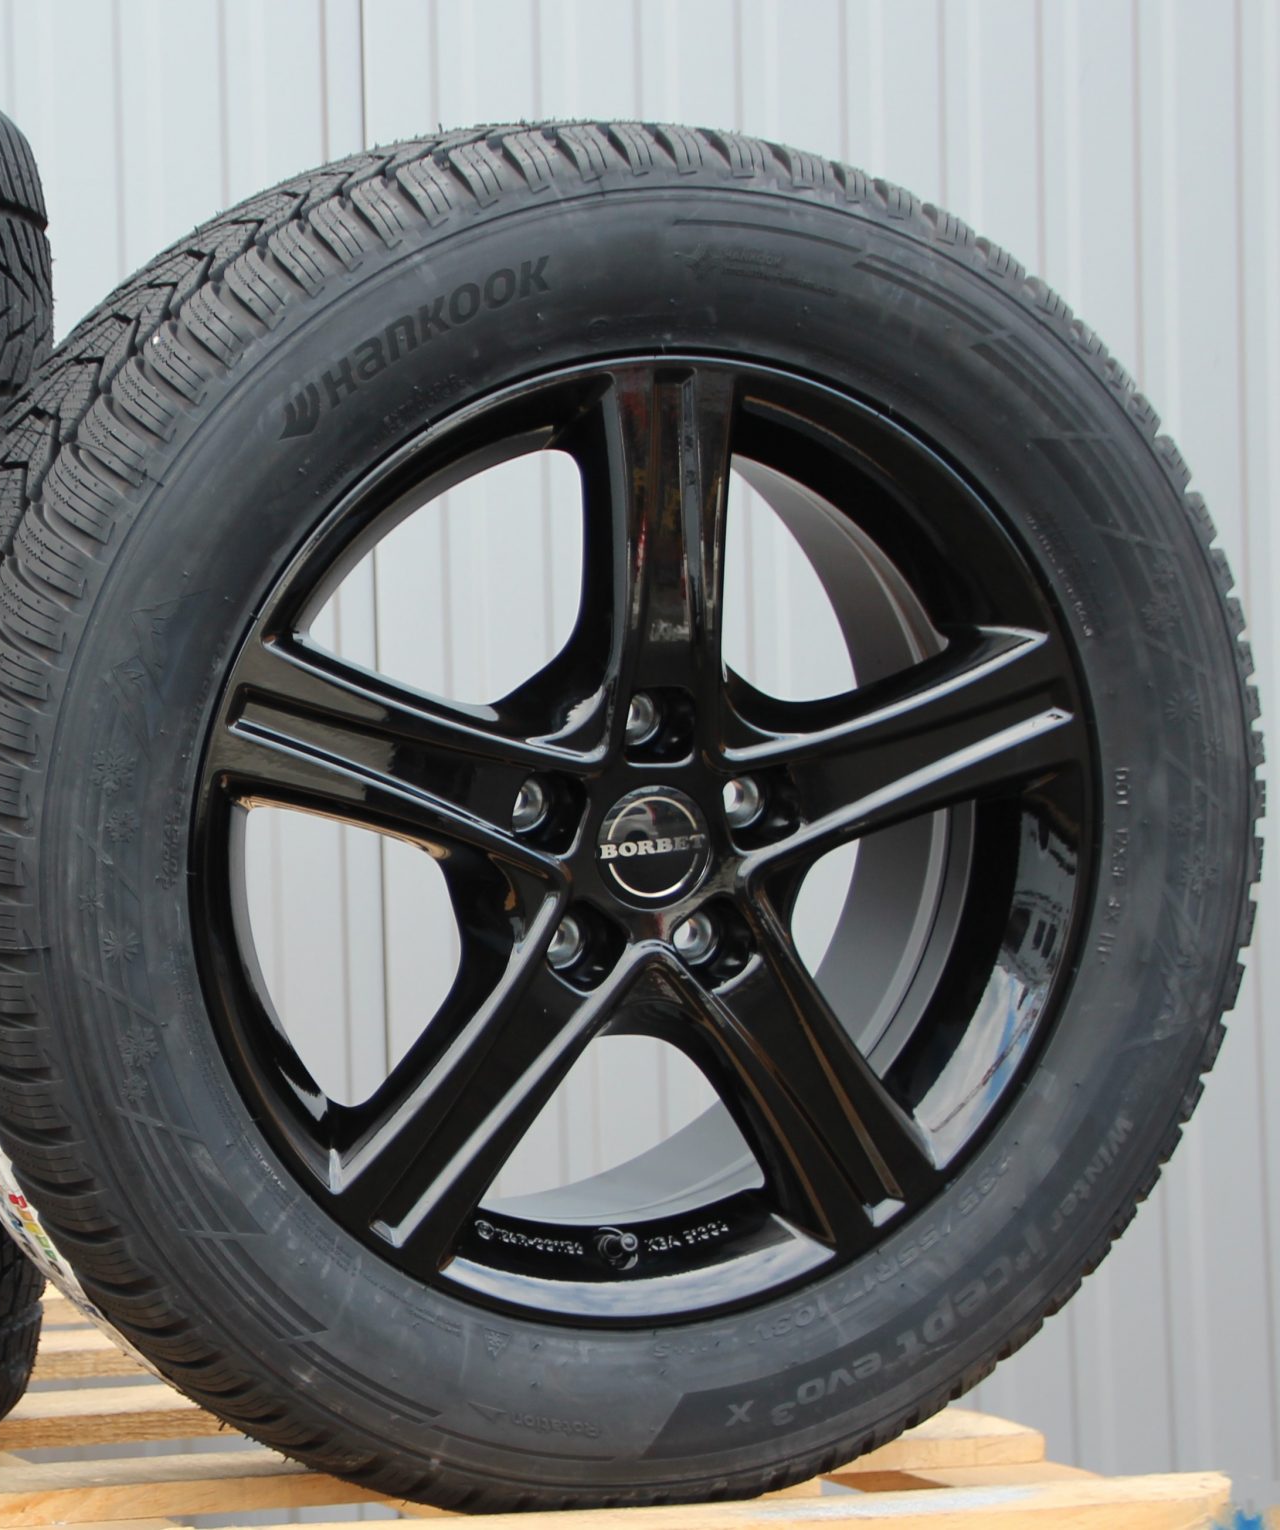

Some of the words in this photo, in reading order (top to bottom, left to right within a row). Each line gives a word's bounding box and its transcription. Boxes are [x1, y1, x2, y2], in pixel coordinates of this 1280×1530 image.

[600, 834, 706, 859] BORBET
[1051, 1111, 1133, 1232] Winter
[512, 1411, 602, 1439] Rotation
